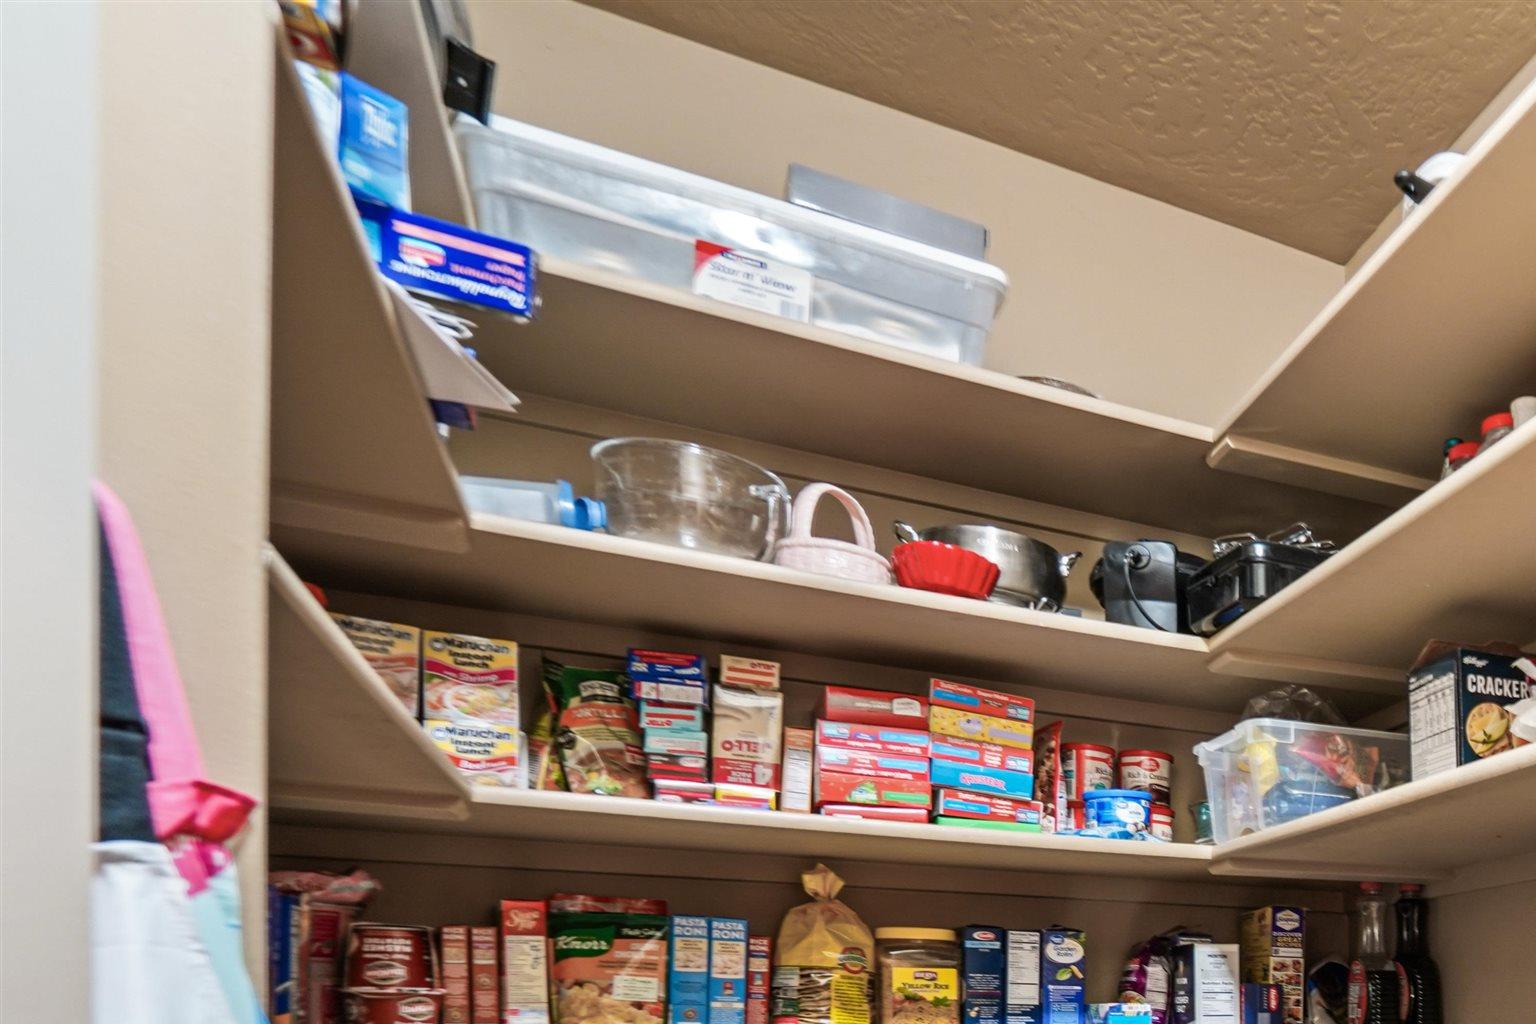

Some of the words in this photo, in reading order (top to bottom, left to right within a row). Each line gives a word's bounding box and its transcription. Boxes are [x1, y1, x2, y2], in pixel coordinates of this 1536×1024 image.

[445, 725, 511, 741] Maruchan
[674, 917, 708, 927] PASTA
[712, 920, 745, 931] PASTA
[675, 926, 708, 937] RONI
[712, 929, 746, 940] RONI
[555, 935, 610, 951] Knorr
[902, 983, 932, 991] YELLOW
[934, 982, 950, 991] RICE
